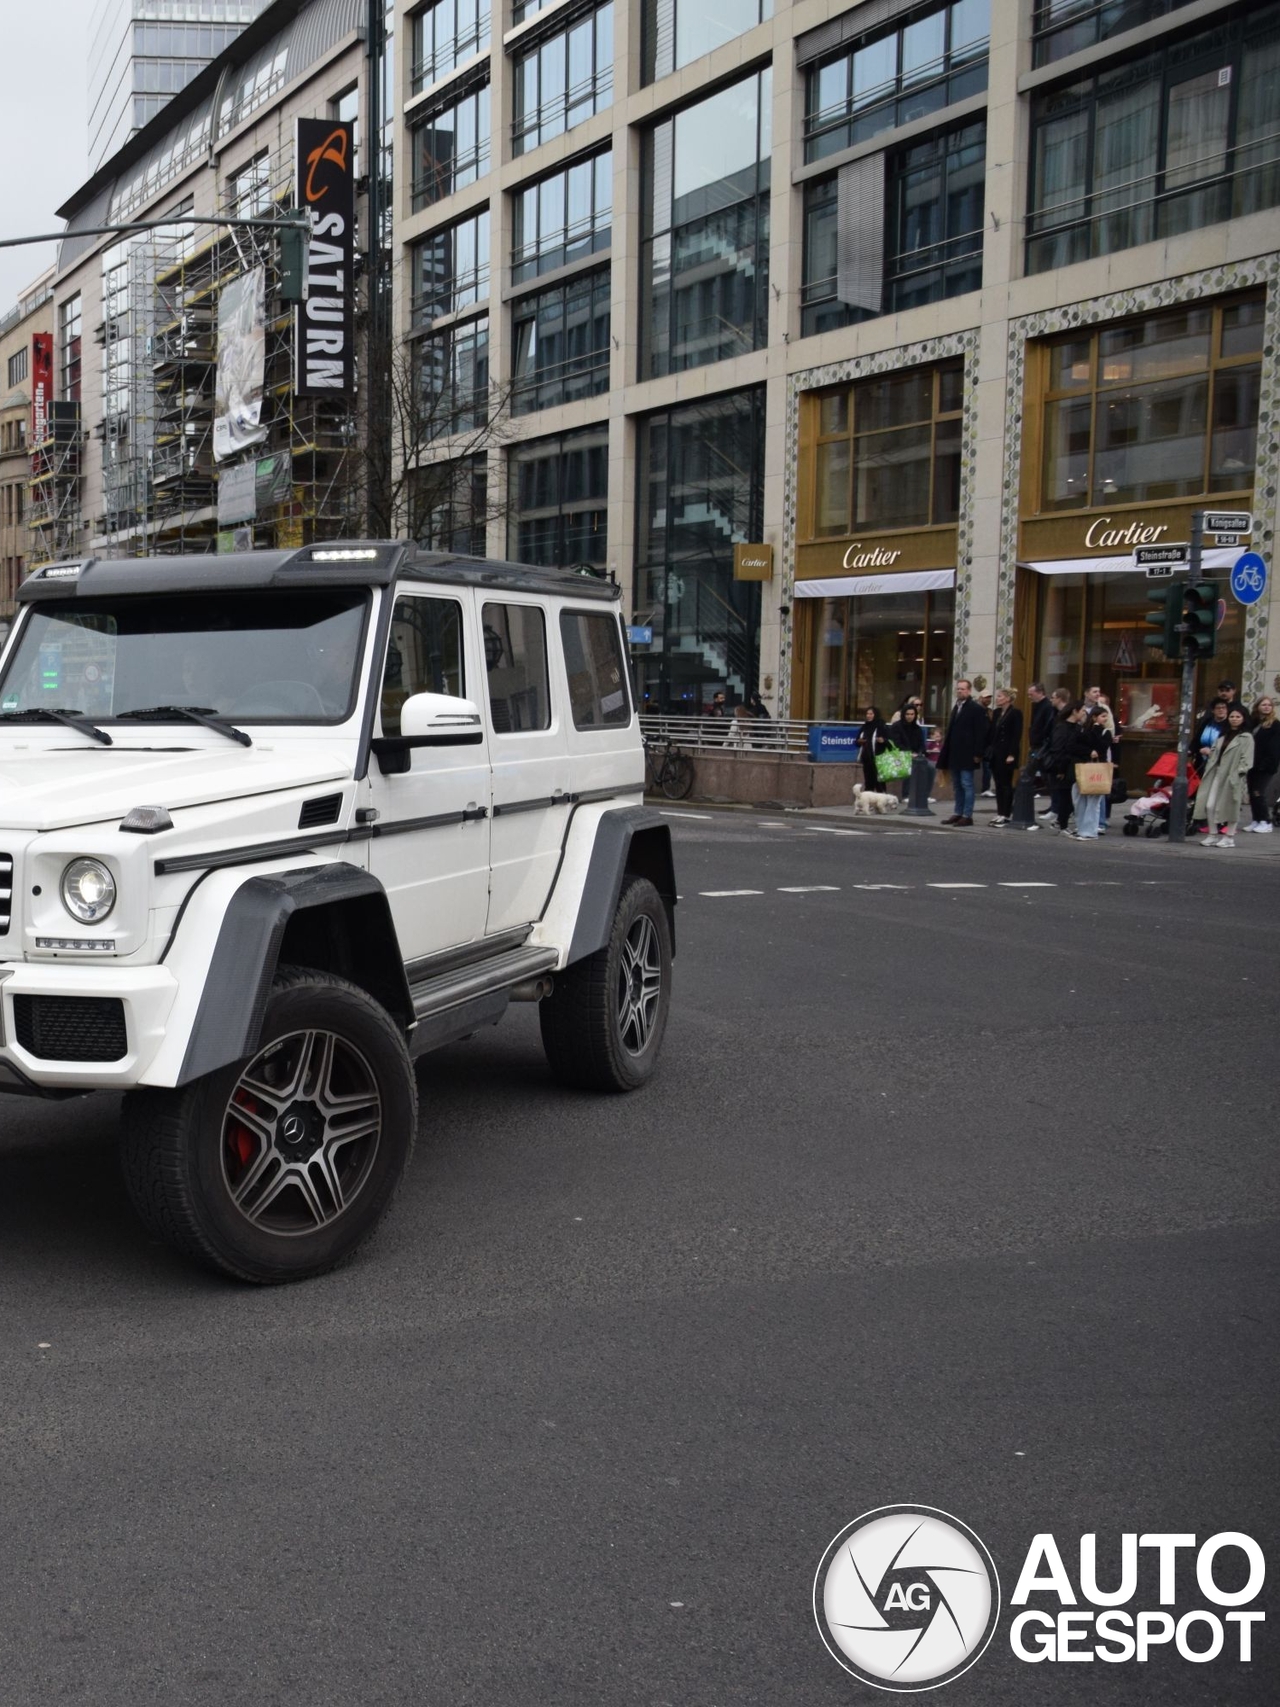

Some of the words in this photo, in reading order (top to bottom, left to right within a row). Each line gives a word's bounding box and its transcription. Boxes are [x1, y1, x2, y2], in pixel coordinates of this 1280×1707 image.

[305, 211, 345, 388] SATURN
[1210, 518, 1247, 529] Königsallee
[1085, 517, 1169, 548] Cartier
[842, 543, 902, 569] Cartier
[1140, 549, 1182, 561] Steinstraße
[741, 557, 768, 568] Cartier
[853, 580, 884, 594] Cartier
[821, 735, 857, 746] Steinstr
